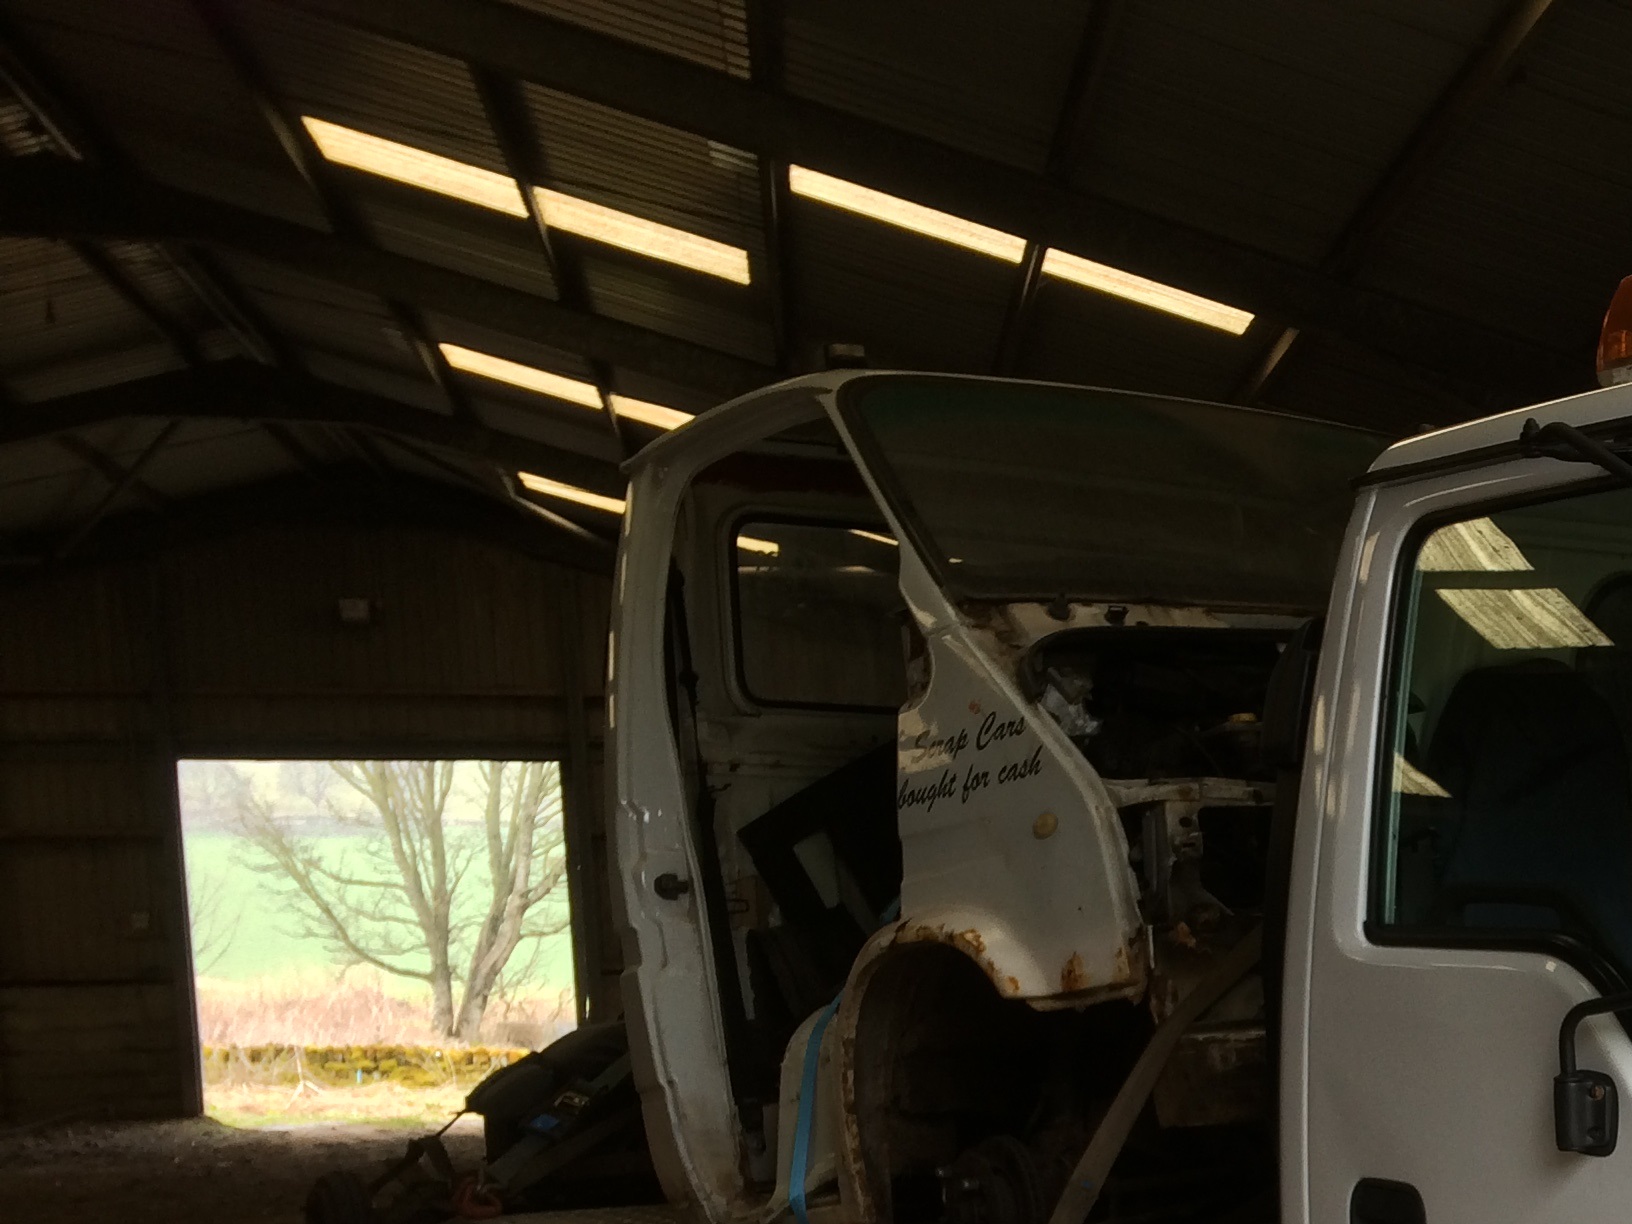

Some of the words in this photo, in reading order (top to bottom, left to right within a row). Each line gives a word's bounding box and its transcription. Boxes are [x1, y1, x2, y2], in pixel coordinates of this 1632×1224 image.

[913, 728, 968, 763] Scrap
[976, 711, 1027, 751] Cars
[897, 769, 957, 812] bought
[961, 764, 991, 804] for
[998, 745, 1043, 784] cash
